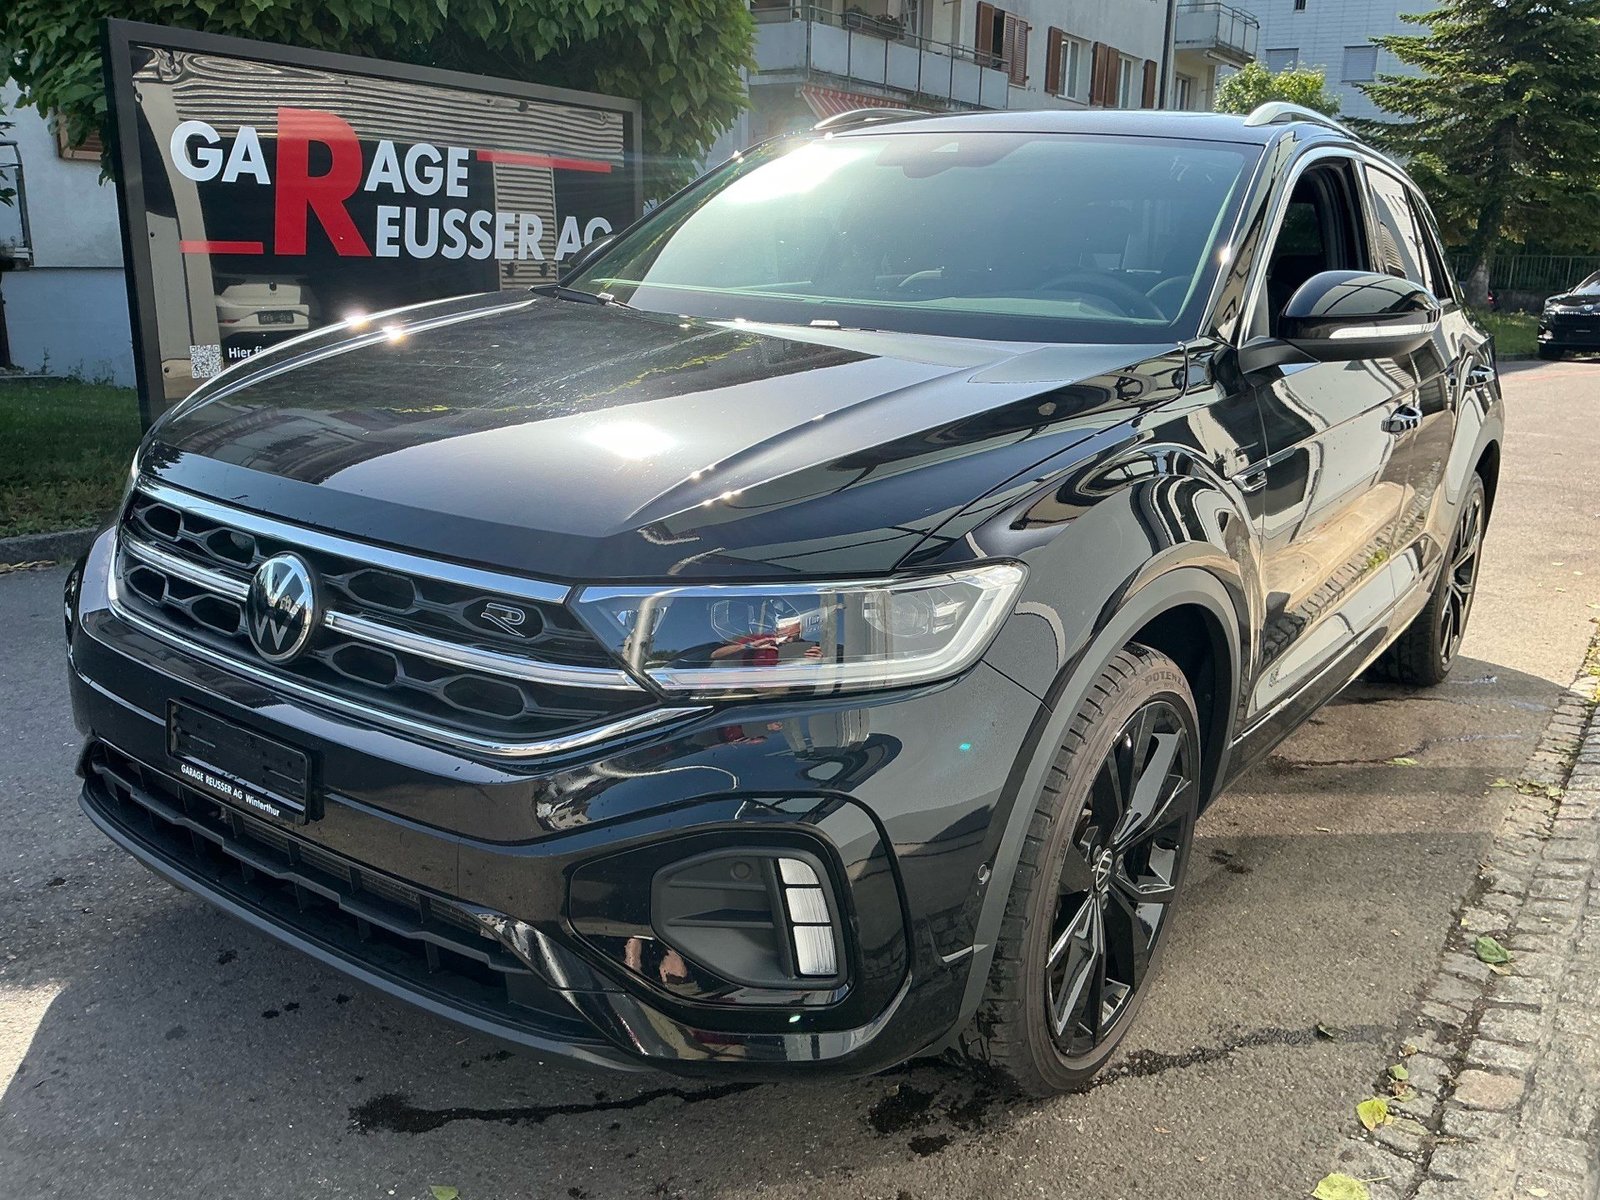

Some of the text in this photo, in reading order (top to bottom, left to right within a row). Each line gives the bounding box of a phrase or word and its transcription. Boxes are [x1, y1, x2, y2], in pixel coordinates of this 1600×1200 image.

[228, 347, 252, 358] Hier
[181, 764, 280, 817] GARAGE REUSSER AG Winterthur
